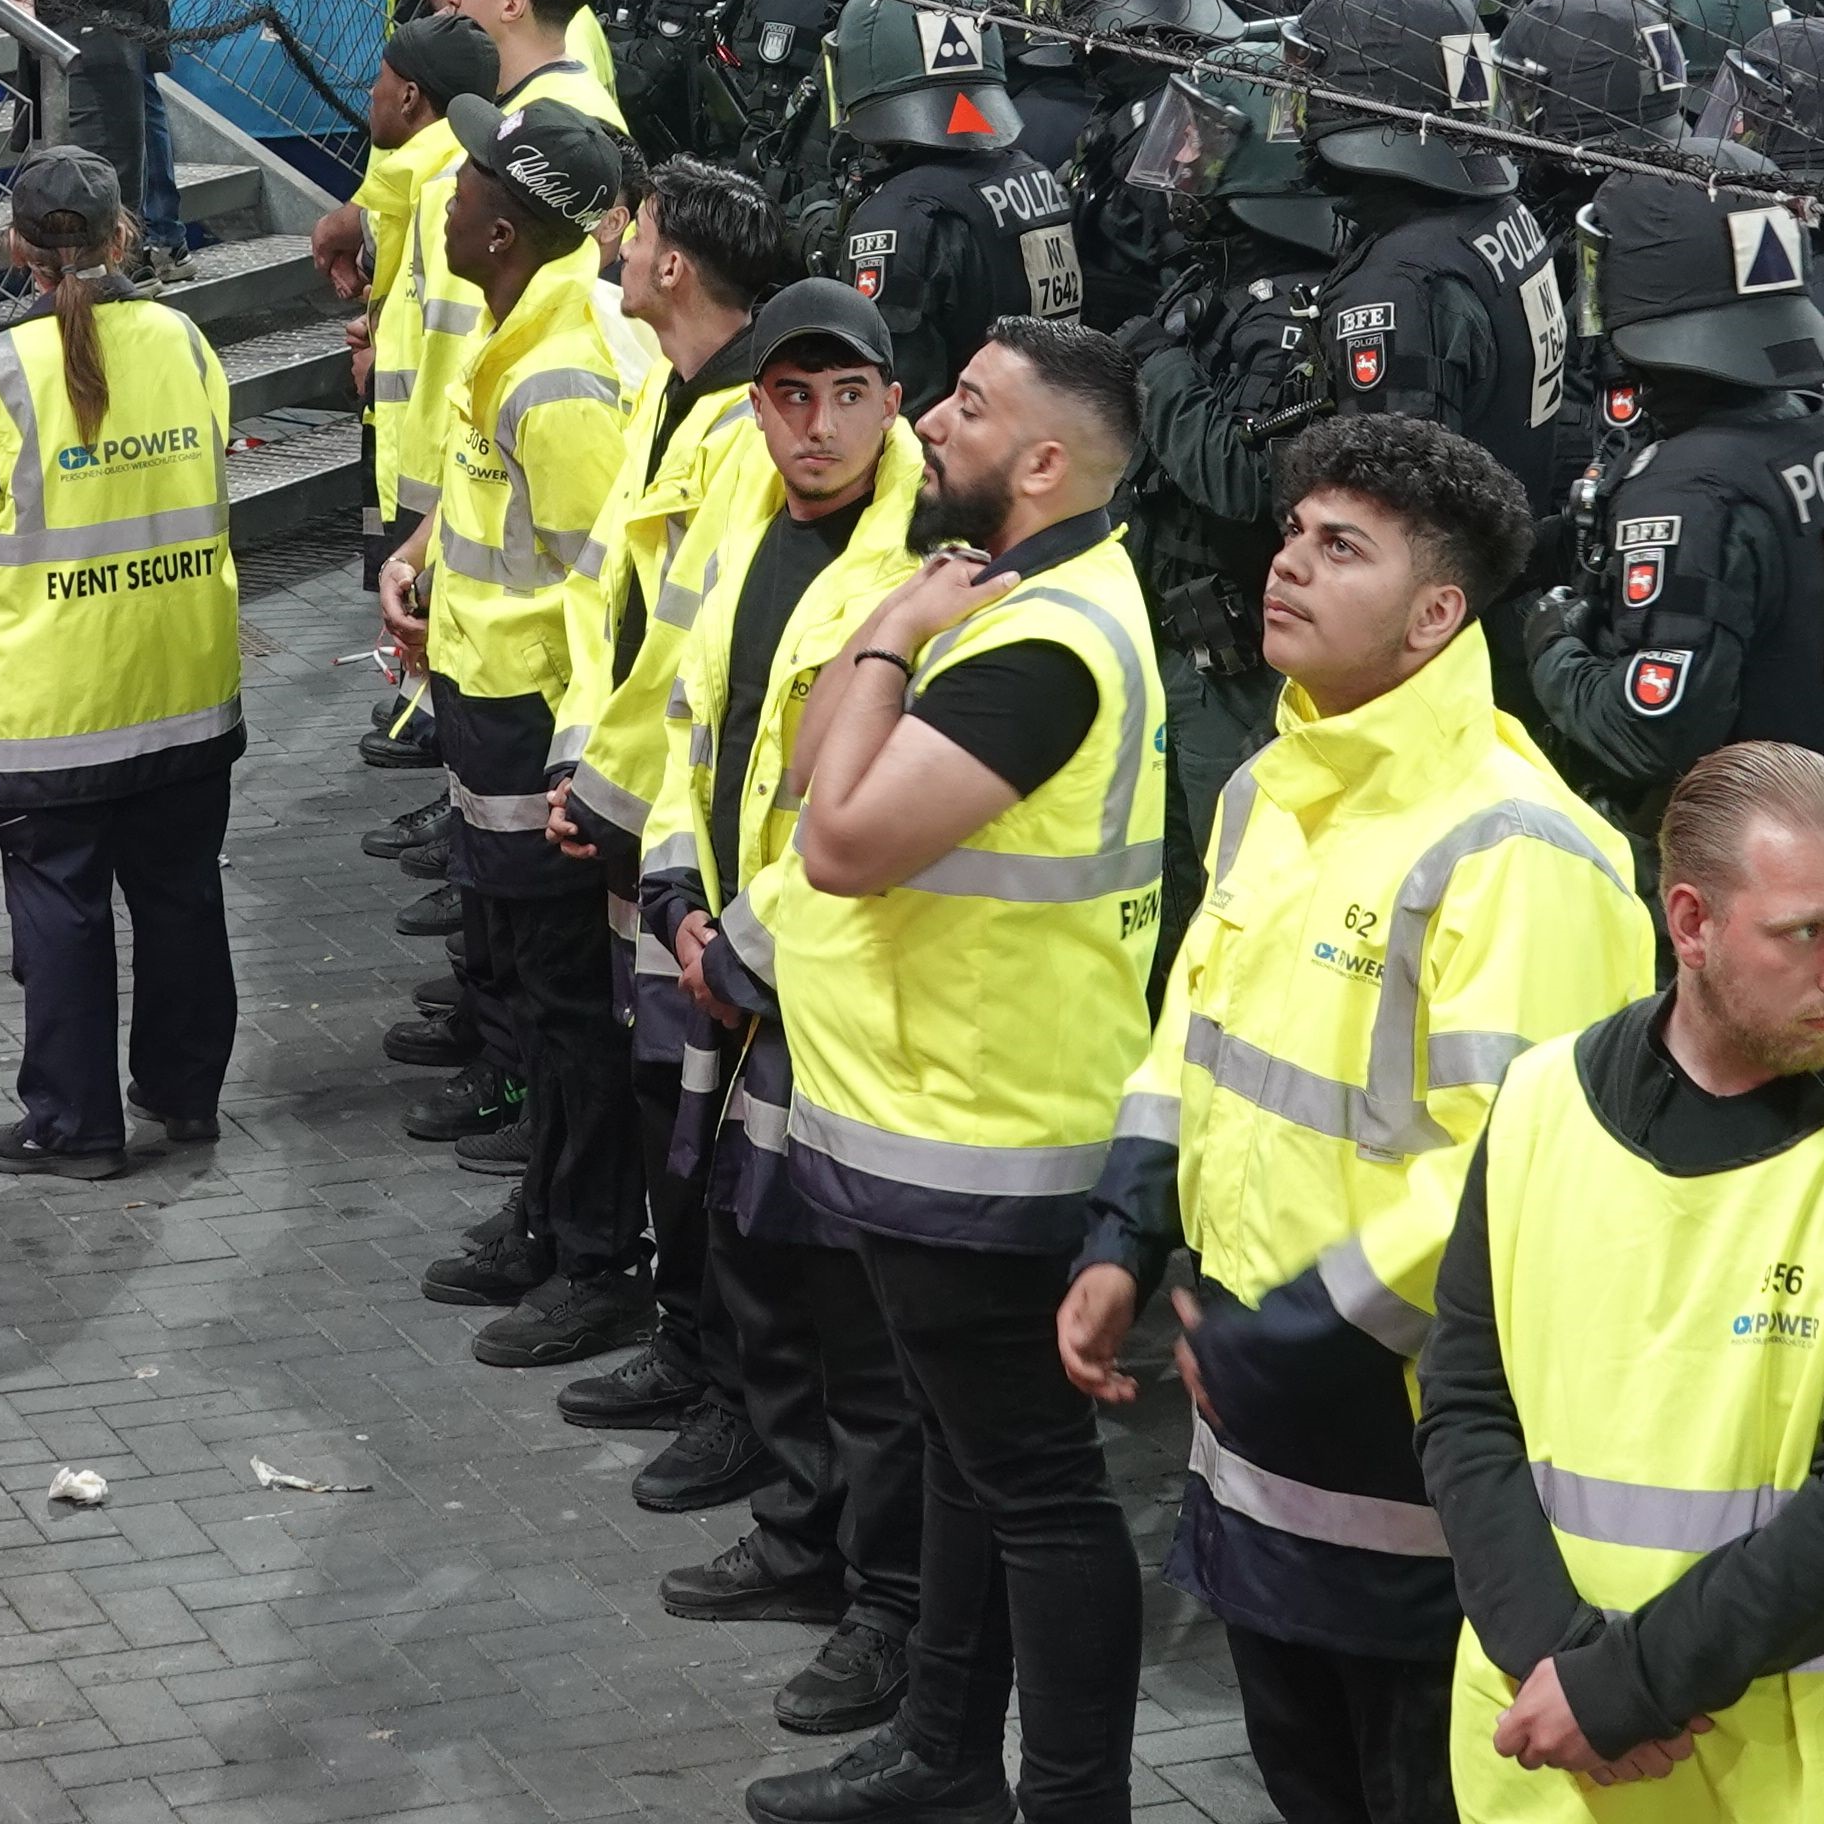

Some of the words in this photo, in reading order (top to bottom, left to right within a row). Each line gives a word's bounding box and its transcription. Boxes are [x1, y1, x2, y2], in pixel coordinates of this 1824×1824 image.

[980, 169, 1072, 229] POLIZE
[855, 234, 888, 254] BFE
[1473, 203, 1547, 283] POLIZ
[1342, 307, 1385, 334] BFE
[1348, 337, 1383, 350] POLIZEI
[103, 425, 201, 464] POWER
[465, 427, 490, 457] 306
[465, 463, 509, 483] OWER
[1625, 522, 1671, 544] BFE
[47, 564, 120, 602] EVENT
[1120, 890, 1161, 941] EVEN
